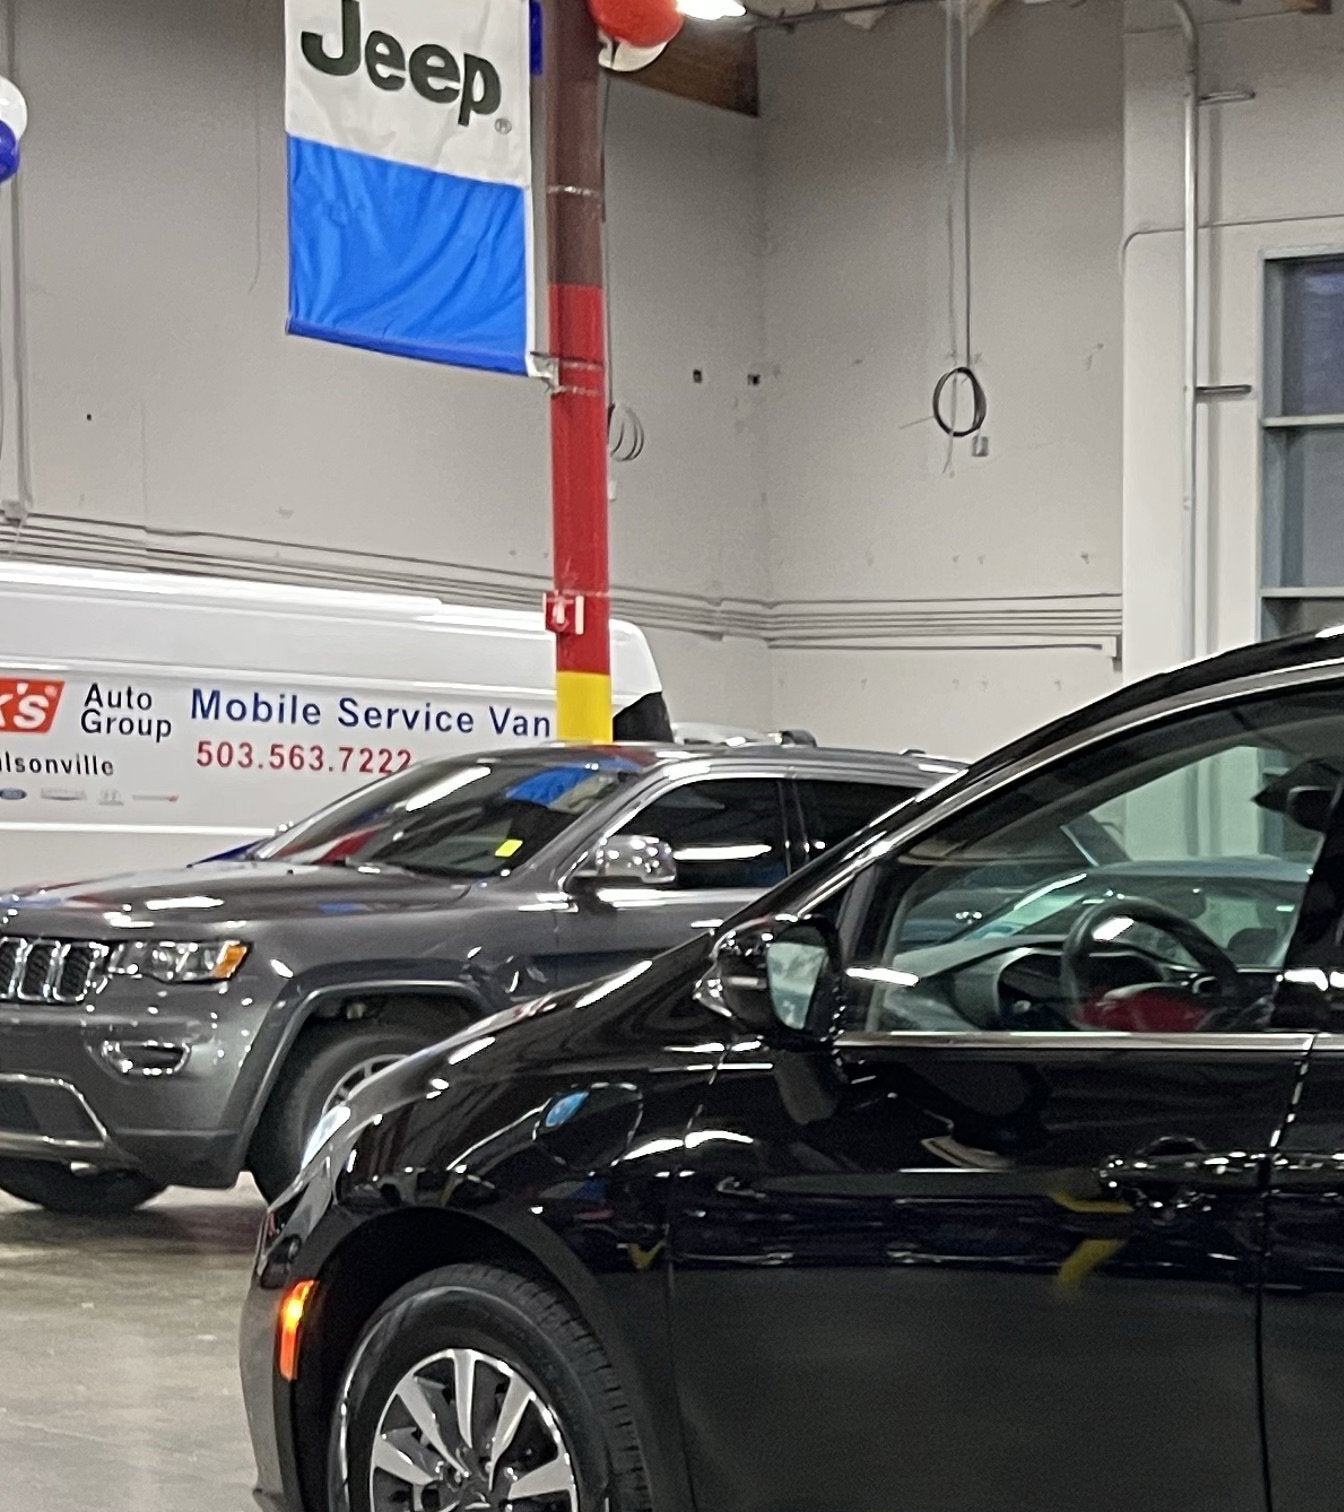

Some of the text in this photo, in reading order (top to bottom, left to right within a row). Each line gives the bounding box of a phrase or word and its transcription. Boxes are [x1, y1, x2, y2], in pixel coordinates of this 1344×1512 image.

[300, 0, 502, 128] Jeep
[84, 682, 152, 710] Auto
[190, 688, 551, 738] Mobile Service Van
[80, 708, 172, 743] Group
[195, 740, 411, 774] 503.563.7222
